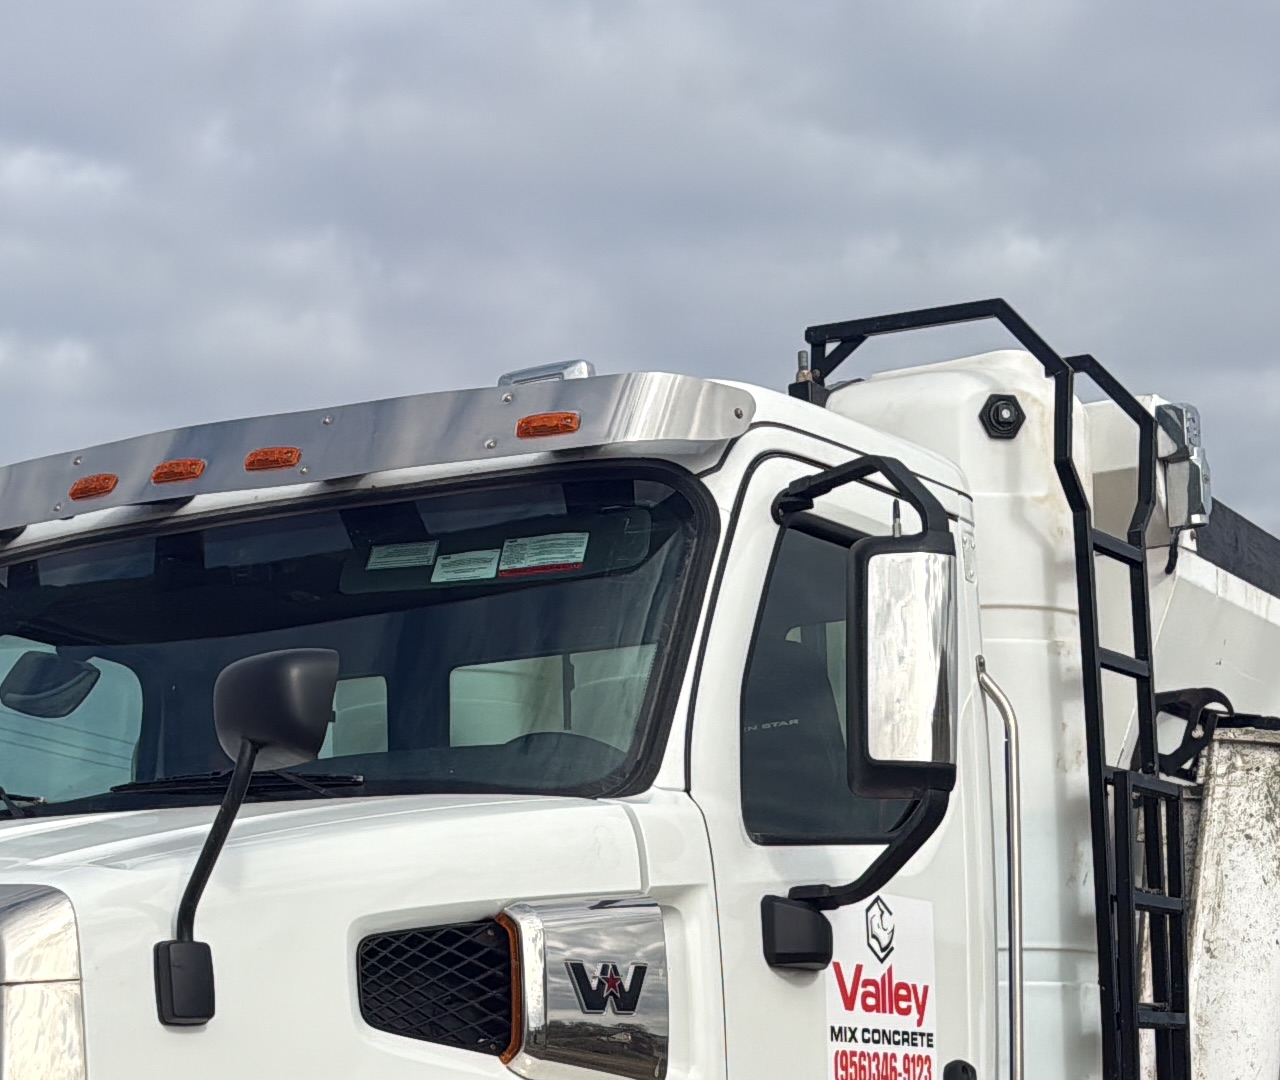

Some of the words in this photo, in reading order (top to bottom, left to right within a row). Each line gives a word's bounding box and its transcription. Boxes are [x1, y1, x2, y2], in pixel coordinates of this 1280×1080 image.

[761, 718, 799, 731] STAR
[832, 961, 928, 1027] Valley
[830, 1025, 859, 1044] MIX
[862, 1028, 934, 1048] CONCRETE
